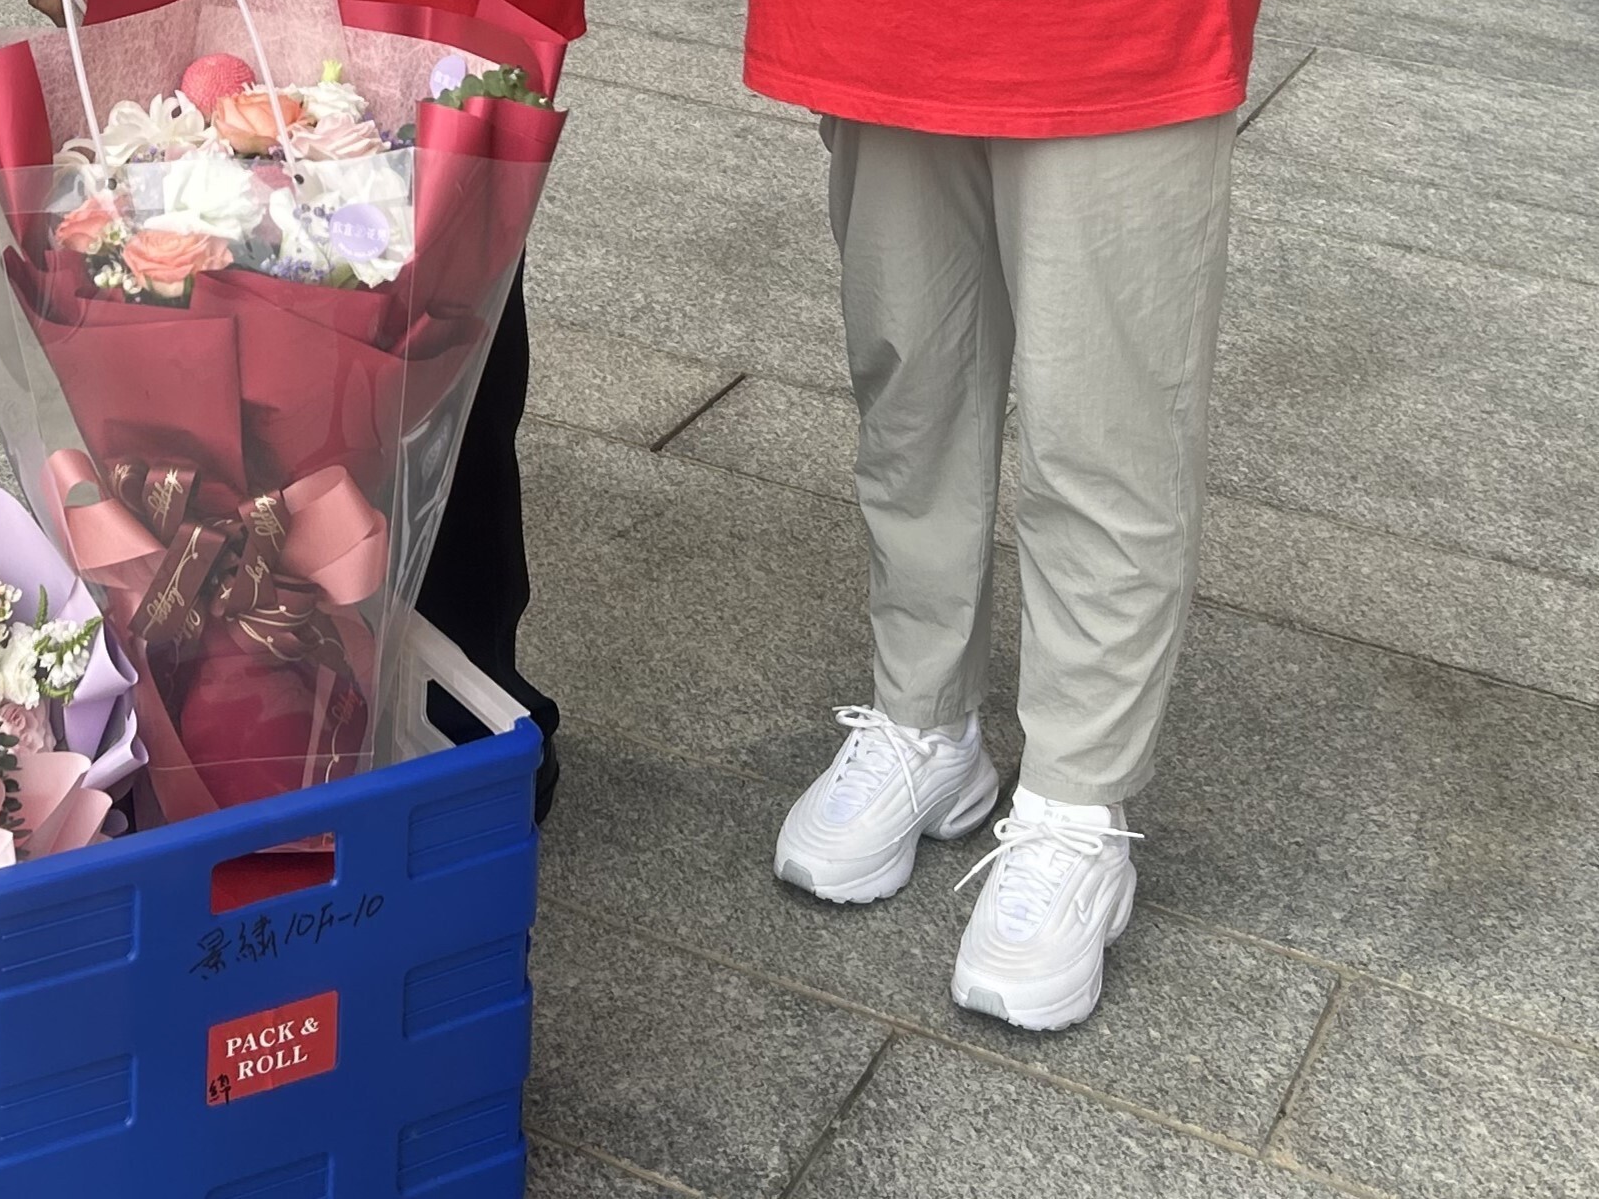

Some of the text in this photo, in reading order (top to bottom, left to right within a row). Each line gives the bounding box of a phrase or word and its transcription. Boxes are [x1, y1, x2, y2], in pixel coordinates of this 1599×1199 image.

[225, 1016, 320, 1058] PACK &
[237, 1045, 309, 1081] ROLL
